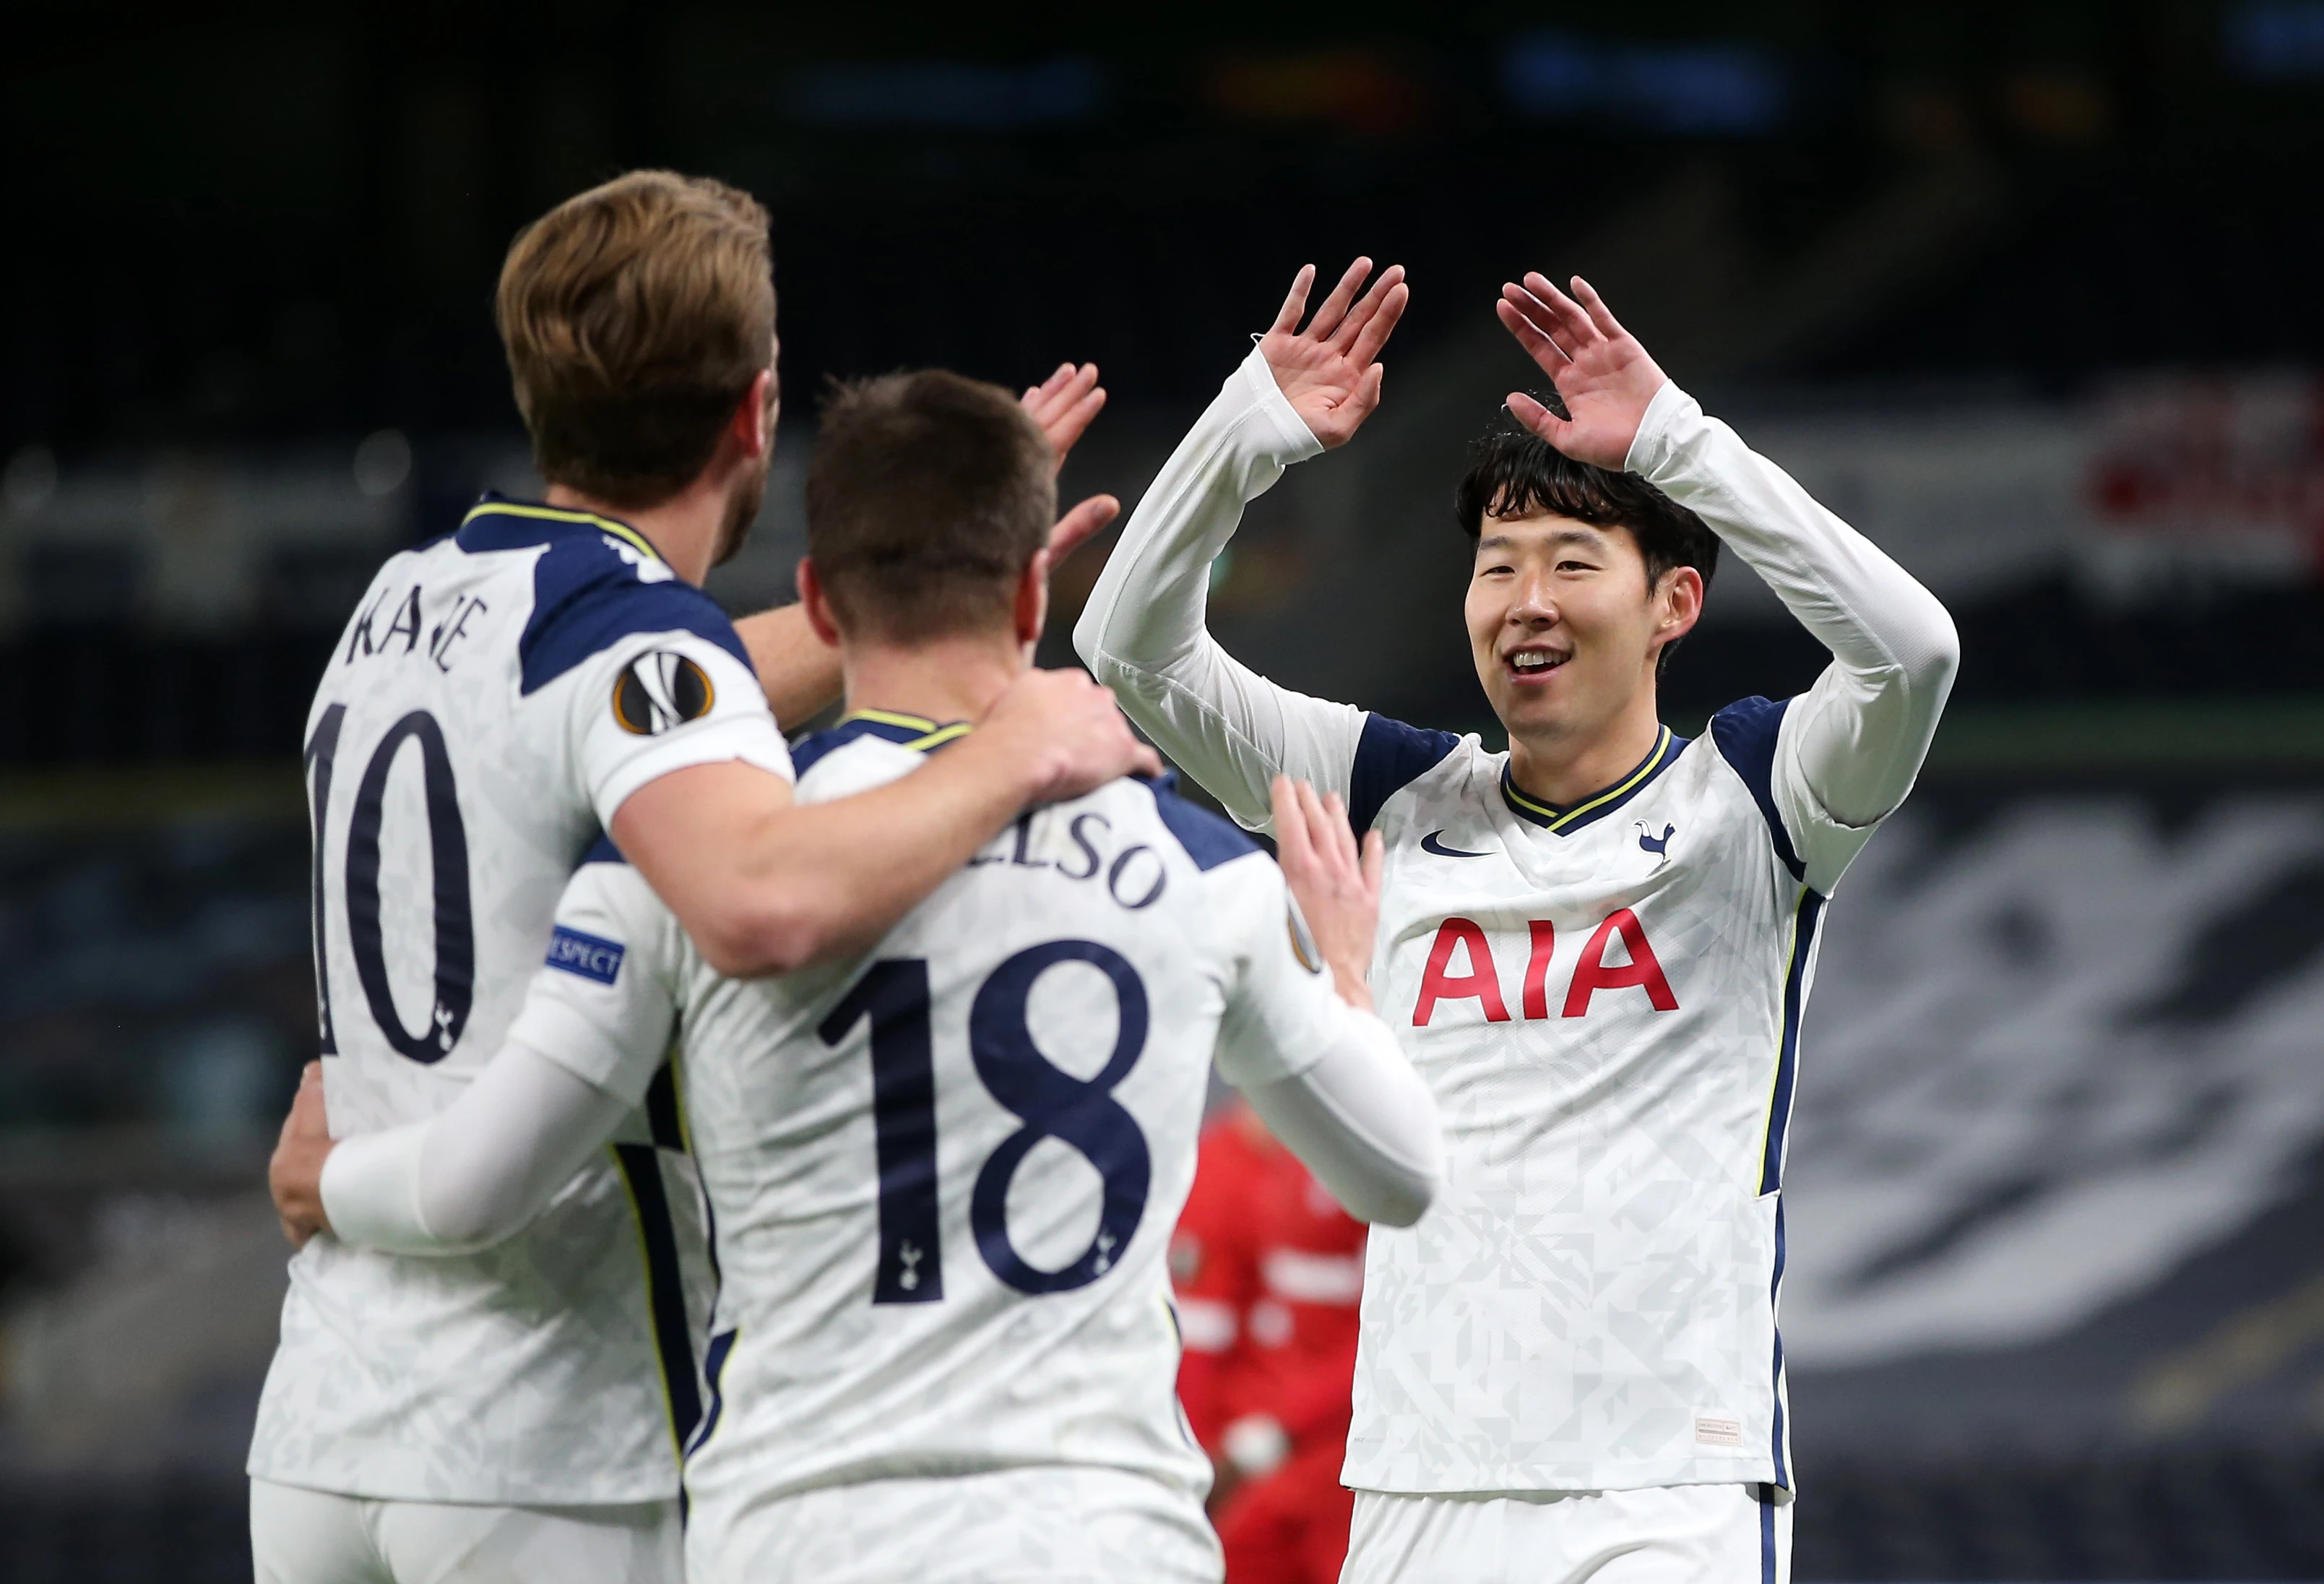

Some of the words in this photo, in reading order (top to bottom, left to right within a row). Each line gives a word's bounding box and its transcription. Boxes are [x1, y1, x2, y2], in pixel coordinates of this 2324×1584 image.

[304, 702, 474, 1065] 10
[967, 811, 1167, 908] LSO
[548, 934, 621, 976] ESPECT
[1412, 908, 1680, 1026] AIA
[817, 939, 1152, 1305] 18
